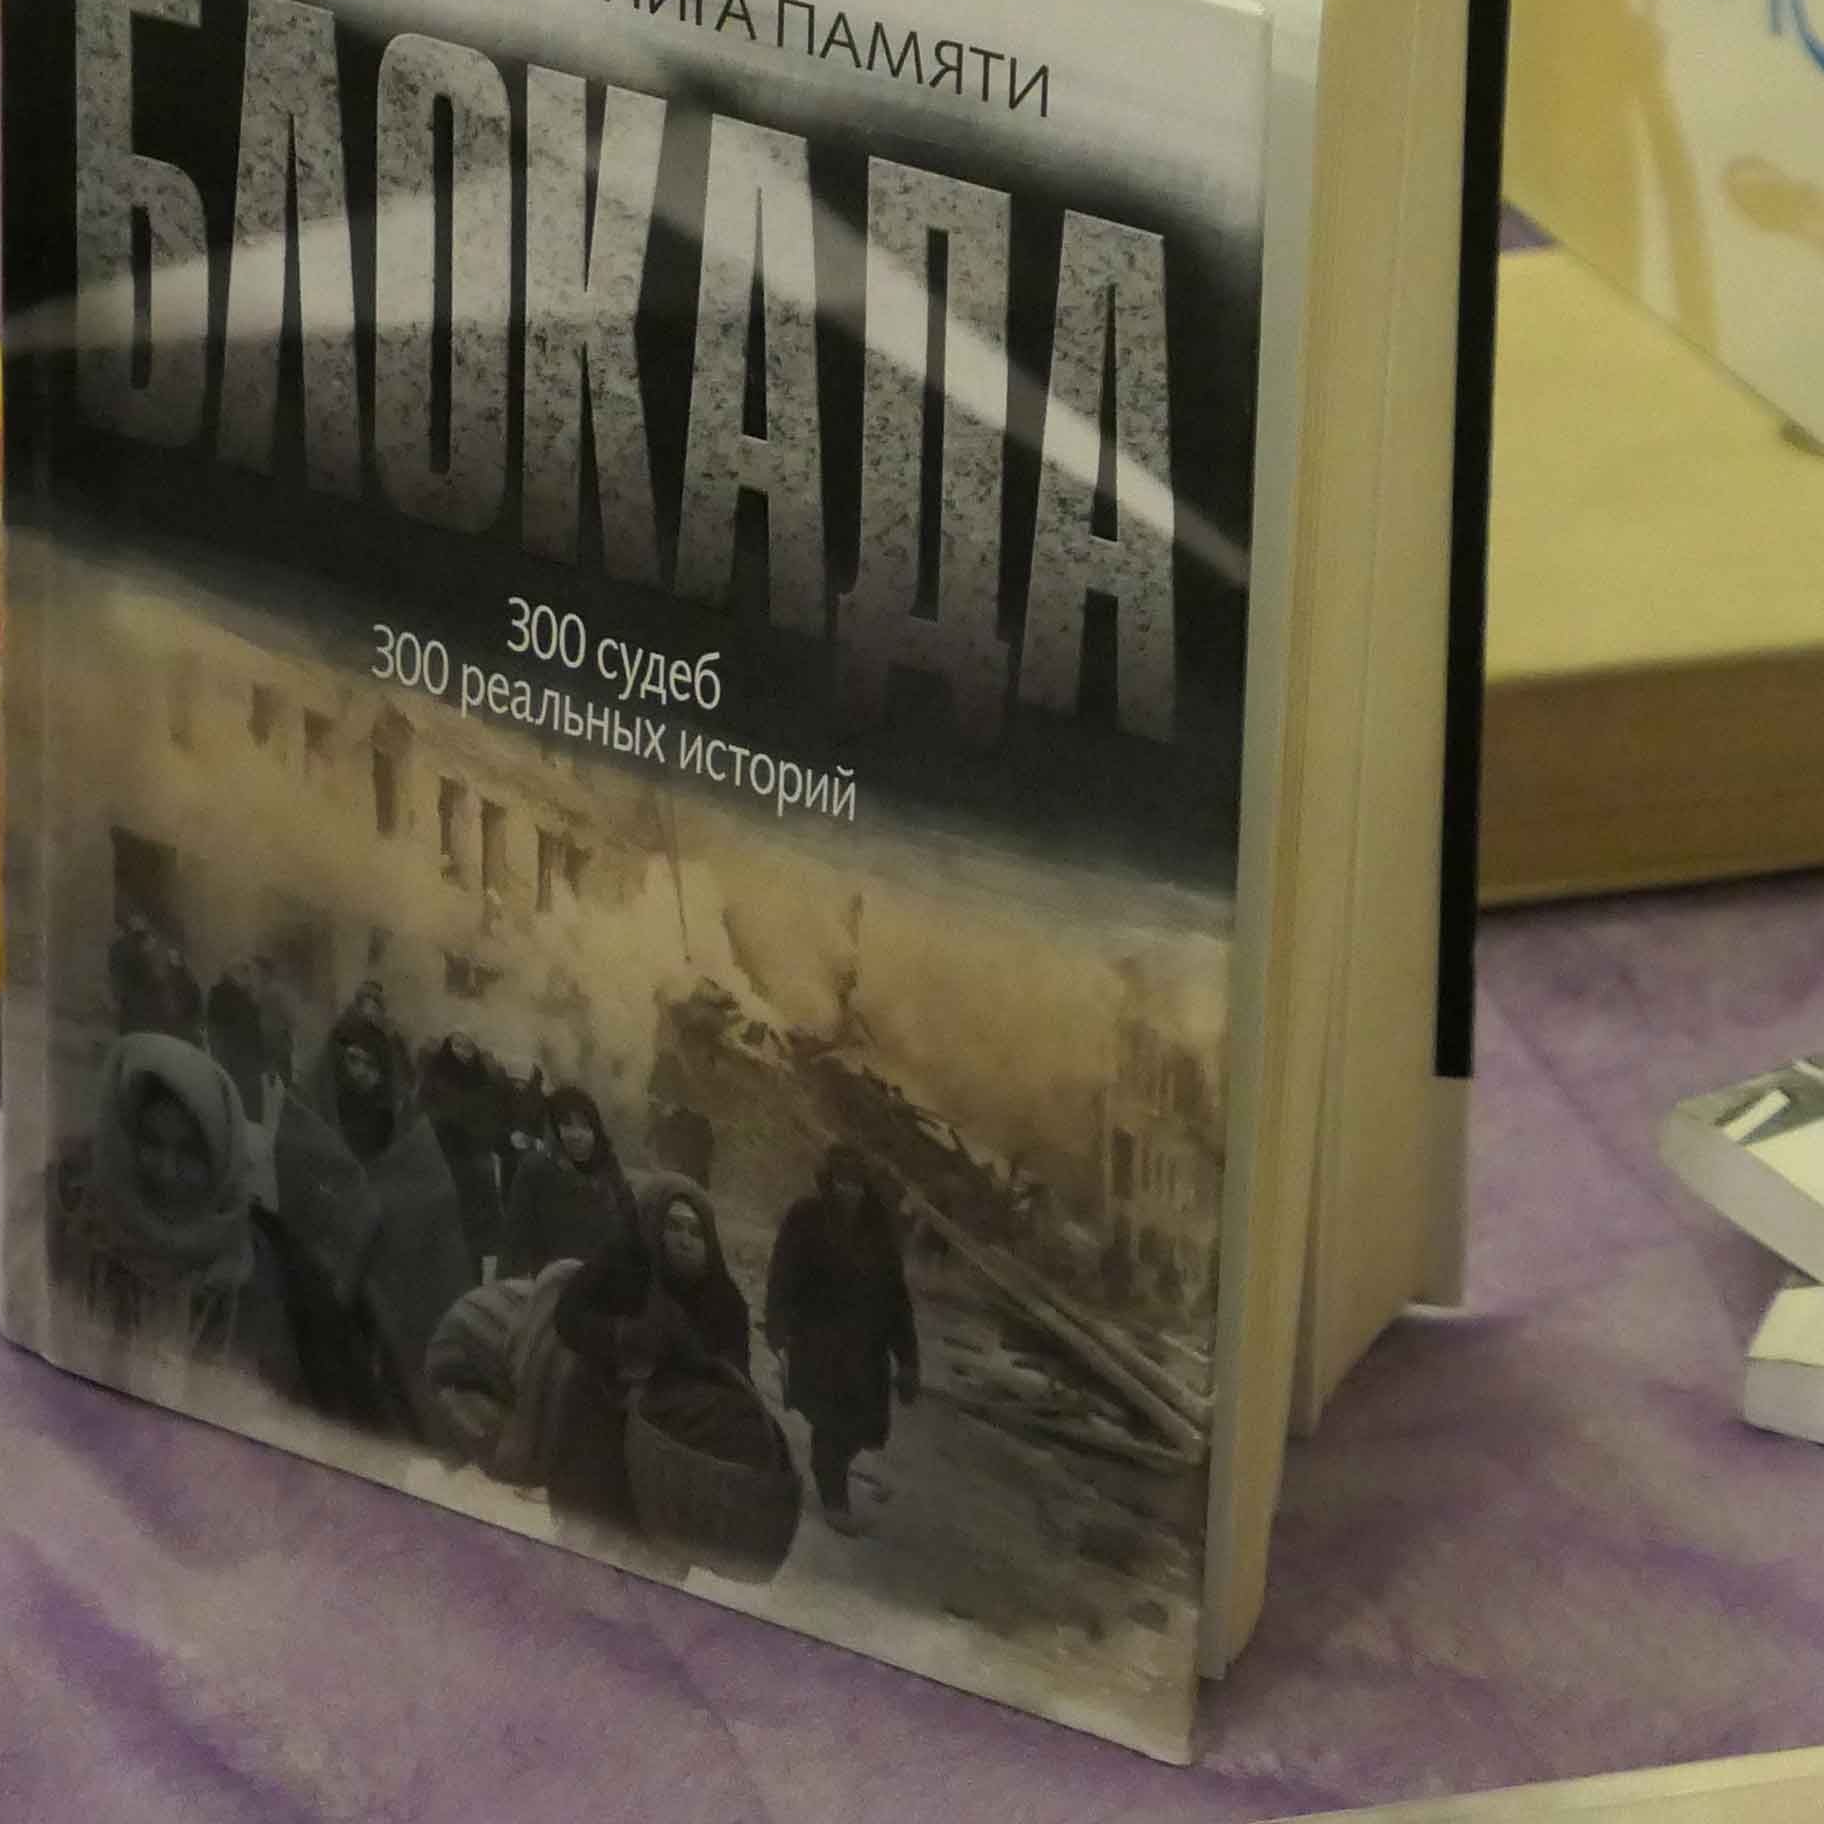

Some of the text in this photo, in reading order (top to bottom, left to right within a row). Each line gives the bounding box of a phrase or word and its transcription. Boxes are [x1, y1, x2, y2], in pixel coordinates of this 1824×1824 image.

[371, 624, 857, 822] 300 реальных историй
[507, 596, 721, 710] 300 судеб
